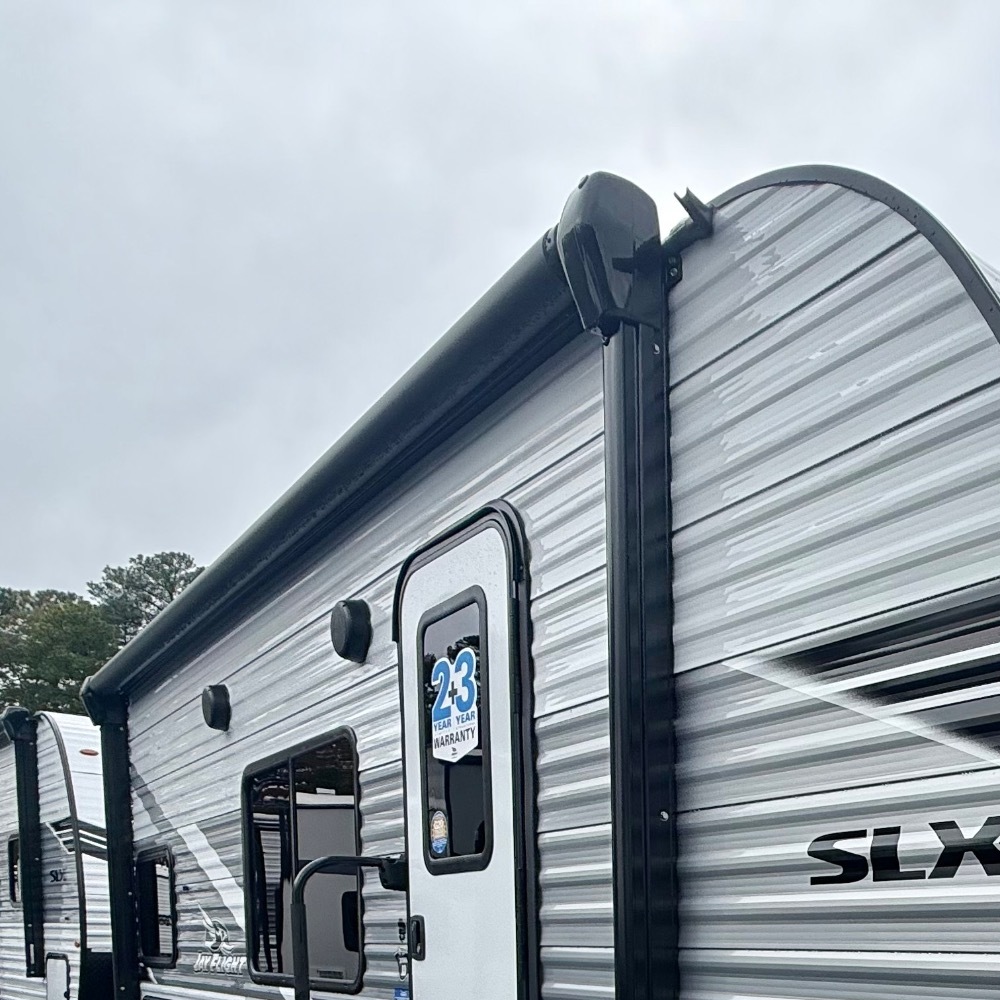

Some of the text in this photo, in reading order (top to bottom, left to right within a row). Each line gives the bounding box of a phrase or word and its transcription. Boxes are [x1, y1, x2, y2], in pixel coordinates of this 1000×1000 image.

[434, 718, 452, 731] YEAR
[455, 710, 476, 726] YEAR
[434, 727, 476, 749] WARRANTY
